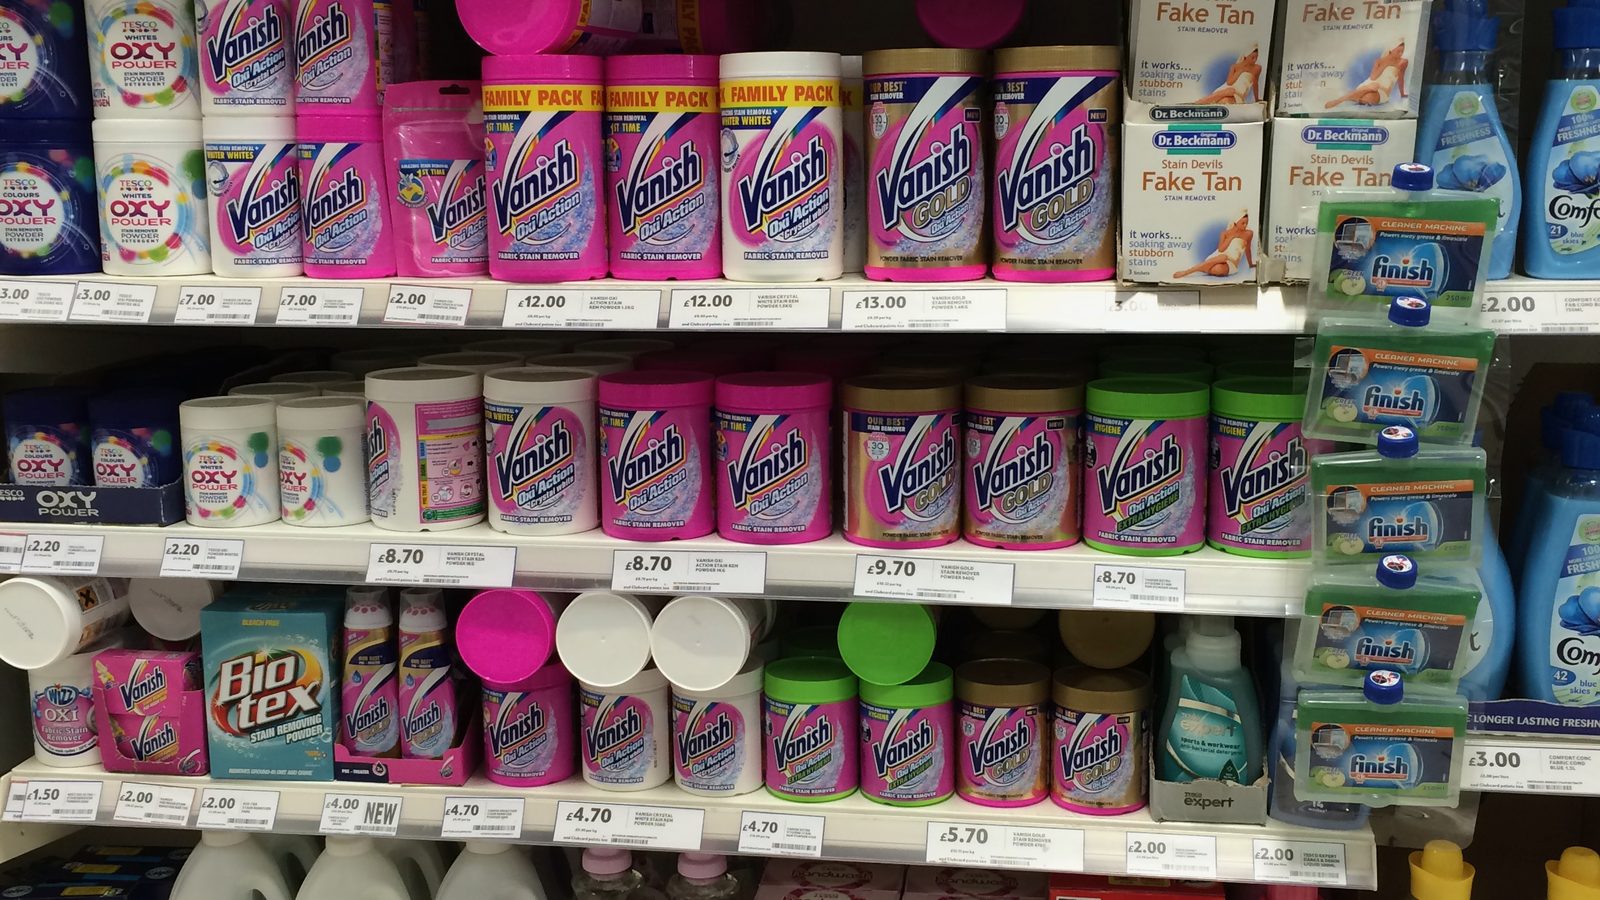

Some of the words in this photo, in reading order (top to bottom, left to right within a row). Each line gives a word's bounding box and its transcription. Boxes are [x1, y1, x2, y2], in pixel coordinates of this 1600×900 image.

[1157, 3, 1209, 22] Fake
[1216, 5, 1254, 25] Tan
[1303, 4, 1354, 22] Fake
[1366, 3, 1400, 20] Tan
[110, 42, 176, 60] OXY
[208, 8, 280, 82] Vanish
[112, 61, 176, 69] POWER
[1140, 71, 1173, 80] soaking
[1140, 80, 1183, 88] stubborn
[485, 90, 530, 105] FAMILY
[538, 90, 582, 105] PACK
[610, 91, 659, 106] FAMILY
[665, 92, 708, 107] PACK
[732, 86, 787, 102] FAMILY
[795, 86, 833, 101] PACK
[1139, 88, 1165, 97] stains
[1155, 110, 1168, 118] Dr.
[1169, 109, 1223, 118] Beckmann
[1157, 135, 1173, 145] Dr.
[1174, 134, 1230, 146] Beckmann
[1307, 129, 1323, 141] Dr.
[1324, 130, 1382, 142] Beckmann
[1162, 159, 1186, 169] Stain
[1189, 159, 1223, 169] Devils
[1311, 154, 1337, 164] Stain
[1341, 155, 1373, 165] Devils
[877, 124, 970, 230] Vanish
[1000, 124, 1093, 231] Vanish
[1143, 171, 1195, 191] Fake
[1202, 172, 1241, 191] Tan
[1290, 167, 1344, 187] Fake
[492, 141, 576, 232] Vanish
[617, 142, 702, 231] Vanish
[739, 138, 825, 234] Vanish
[111, 200, 170, 217] OXY
[912, 177, 970, 228] GOLD
[1031, 178, 1093, 231] GOLD
[111, 218, 171, 226] POWER
[1381, 221, 1422, 231] CLEANER
[1425, 224, 1467, 232] MACHINE
[1130, 230, 1136, 239] it
[1550, 226, 1561, 235] 21
[1129, 240, 1164, 250] soaking
[1168, 241, 1192, 250] away
[1129, 248, 1173, 257] stubborn
[519, 252, 541, 260] STAIN
[542, 252, 579, 260] REMOVER
[643, 252, 665, 260] STAIN
[666, 252, 702, 260] REMOVER
[1129, 257, 1157, 266] stains
[1372, 254, 1433, 281] finish
[77, 289, 110, 301] £3.00
[180, 294, 215, 305] £7.00
[281, 295, 316, 306] £7.00
[390, 293, 425, 305] £2.00
[518, 295, 565, 309] £12.00
[683, 295, 732, 308] £12.00
[856, 296, 906, 309] £13.00
[1375, 353, 1415, 363] CLEANER
[1417, 357, 1460, 366] MACHINE
[1364, 385, 1424, 411] finish
[17, 459, 64, 472] OXY
[496, 418, 571, 498] Vanish
[609, 425, 683, 502] Vanish
[96, 463, 135, 477] OXY
[728, 429, 806, 508] Vanish
[880, 430, 955, 512] Vanish
[974, 433, 1053, 511] Vanish
[1097, 436, 1181, 515] Vanish
[191, 470, 237, 484] OXY
[1222, 438, 1306, 515] Vanish
[1001, 472, 1052, 513] GOLD
[1371, 485, 1410, 493] CLEANER
[36, 491, 96, 507] OXY
[38, 508, 99, 516] POWER
[1369, 517, 1429, 537] finish
[27, 541, 60, 552] £2.20
[166, 544, 199, 555] £2.20
[378, 549, 423, 564] £8.70
[625, 556, 672, 571] £8.70
[867, 561, 916, 576] £9.70
[1097, 572, 1135, 584] £8.70
[1366, 609, 1406, 617] CLEANER
[1408, 614, 1448, 622] MACHINE
[1356, 638, 1415, 660] finish
[219, 654, 296, 703] Bio
[1554, 671, 1568, 681] 42
[121, 666, 166, 709] Vanish
[1569, 687, 1591, 696] skies
[48, 688, 76, 706] WIZZ
[237, 683, 320, 729] tex
[44, 707, 80, 722] OXI
[347, 696, 388, 738] Vanish
[402, 700, 440, 741] Vanish
[1474, 714, 1514, 724] LONGER
[1517, 717, 1560, 726] LASTING
[250, 728, 276, 742] STAIN
[277, 714, 322, 734] REMOVING
[286, 726, 323, 744] POWDER
[490, 702, 543, 756] Vanish
[587, 707, 639, 759] Vanish
[47, 734, 82, 742] Remover
[132, 721, 177, 760] Vanish
[678, 713, 730, 767] Vanish
[774, 714, 831, 770] Vanish
[1180, 737, 1200, 746] sports
[872, 719, 931, 777] Vanish
[970, 719, 1030, 774] Vanish
[1061, 728, 1120, 779] Vanish
[1351, 754, 1408, 774] finish
[1468, 752, 1520, 768] £3.00
[27, 789, 60, 801] £1.50
[120, 791, 152, 804] £2.00
[202, 798, 235, 809] £2.00
[325, 798, 360, 810] £4.00
[445, 804, 479, 816] £4.70
[1184, 796, 1234, 810] expert
[364, 802, 398, 826] NEW
[566, 808, 612, 824] £4.70
[743, 822, 778, 833] £4.70
[940, 827, 988, 844] £5.70
[1128, 842, 1166, 854] £2.00
[1255, 848, 1294, 861] £2.00
